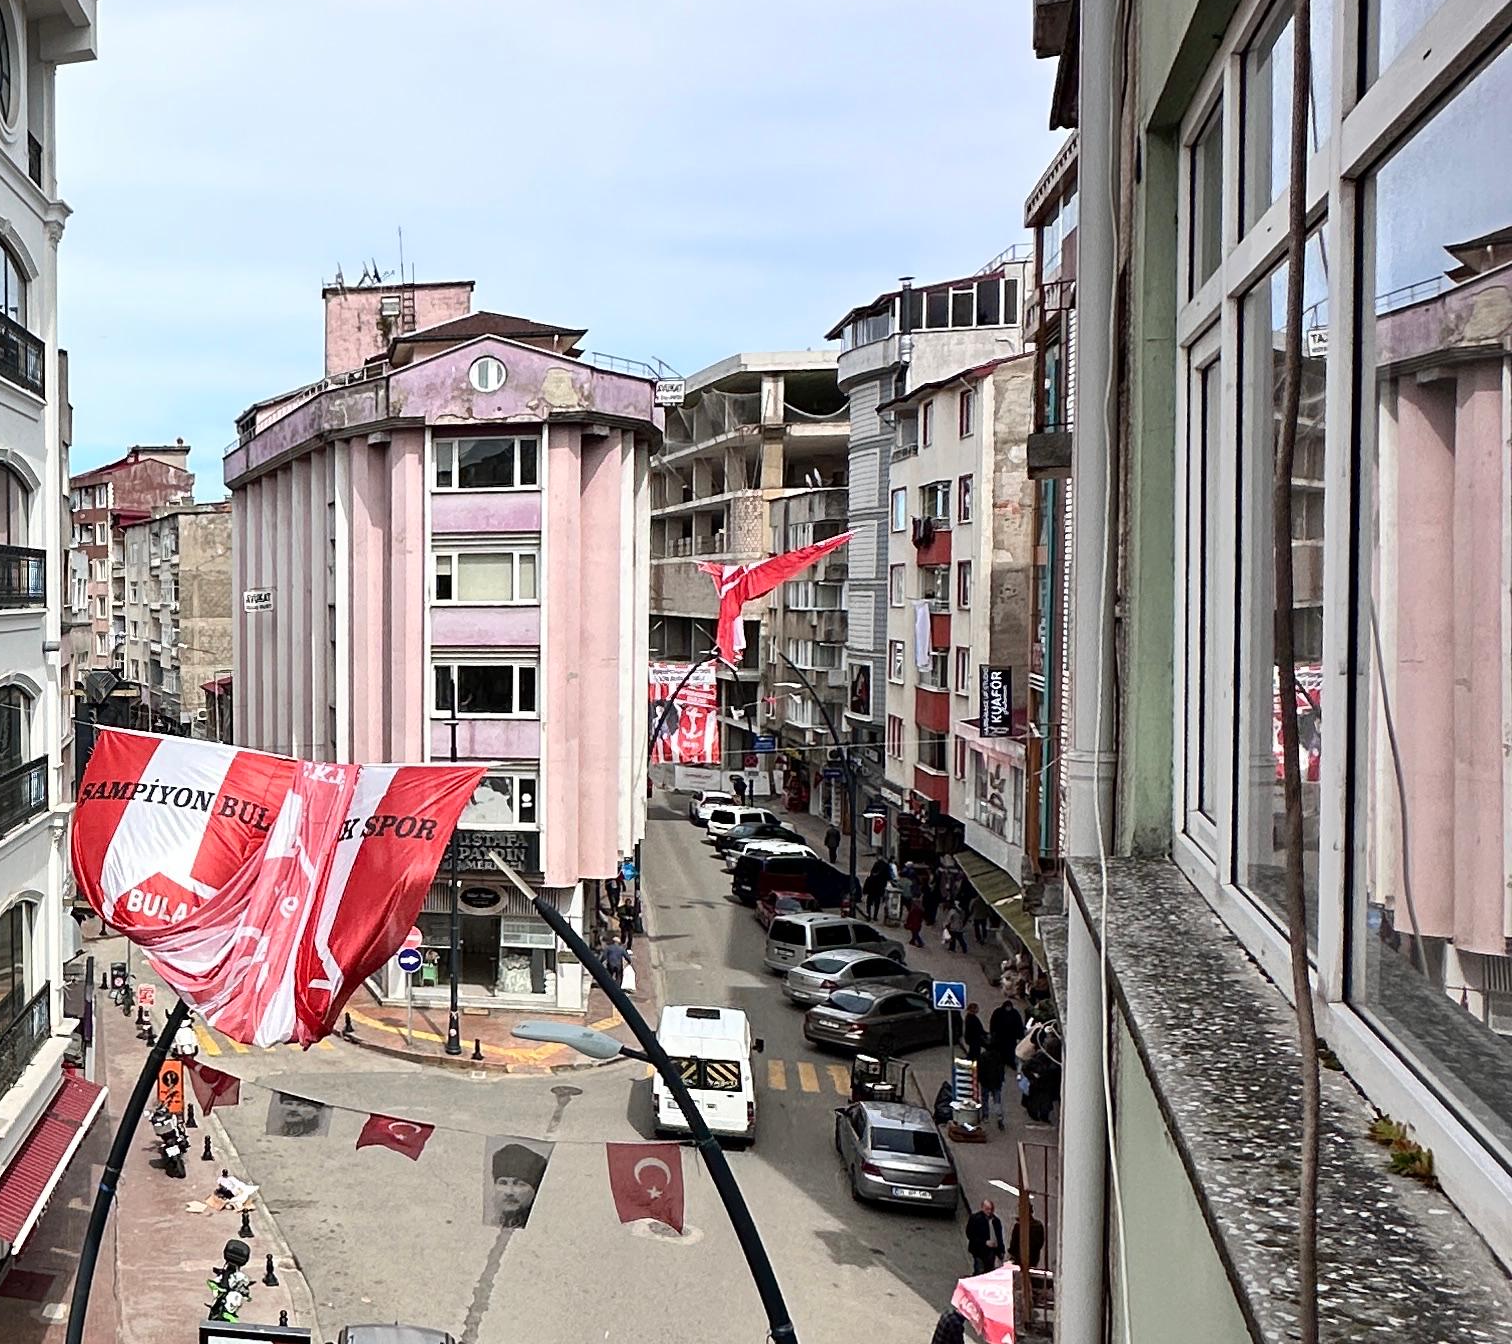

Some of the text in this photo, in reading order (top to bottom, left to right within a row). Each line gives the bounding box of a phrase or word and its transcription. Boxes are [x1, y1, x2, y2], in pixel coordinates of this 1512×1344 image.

[989, 671, 1003, 723] KUAFÖR
[76, 779, 216, 813] ŞAMPİYON
[360, 814, 438, 841] SPOR
[446, 832, 529, 847] USTAFA
